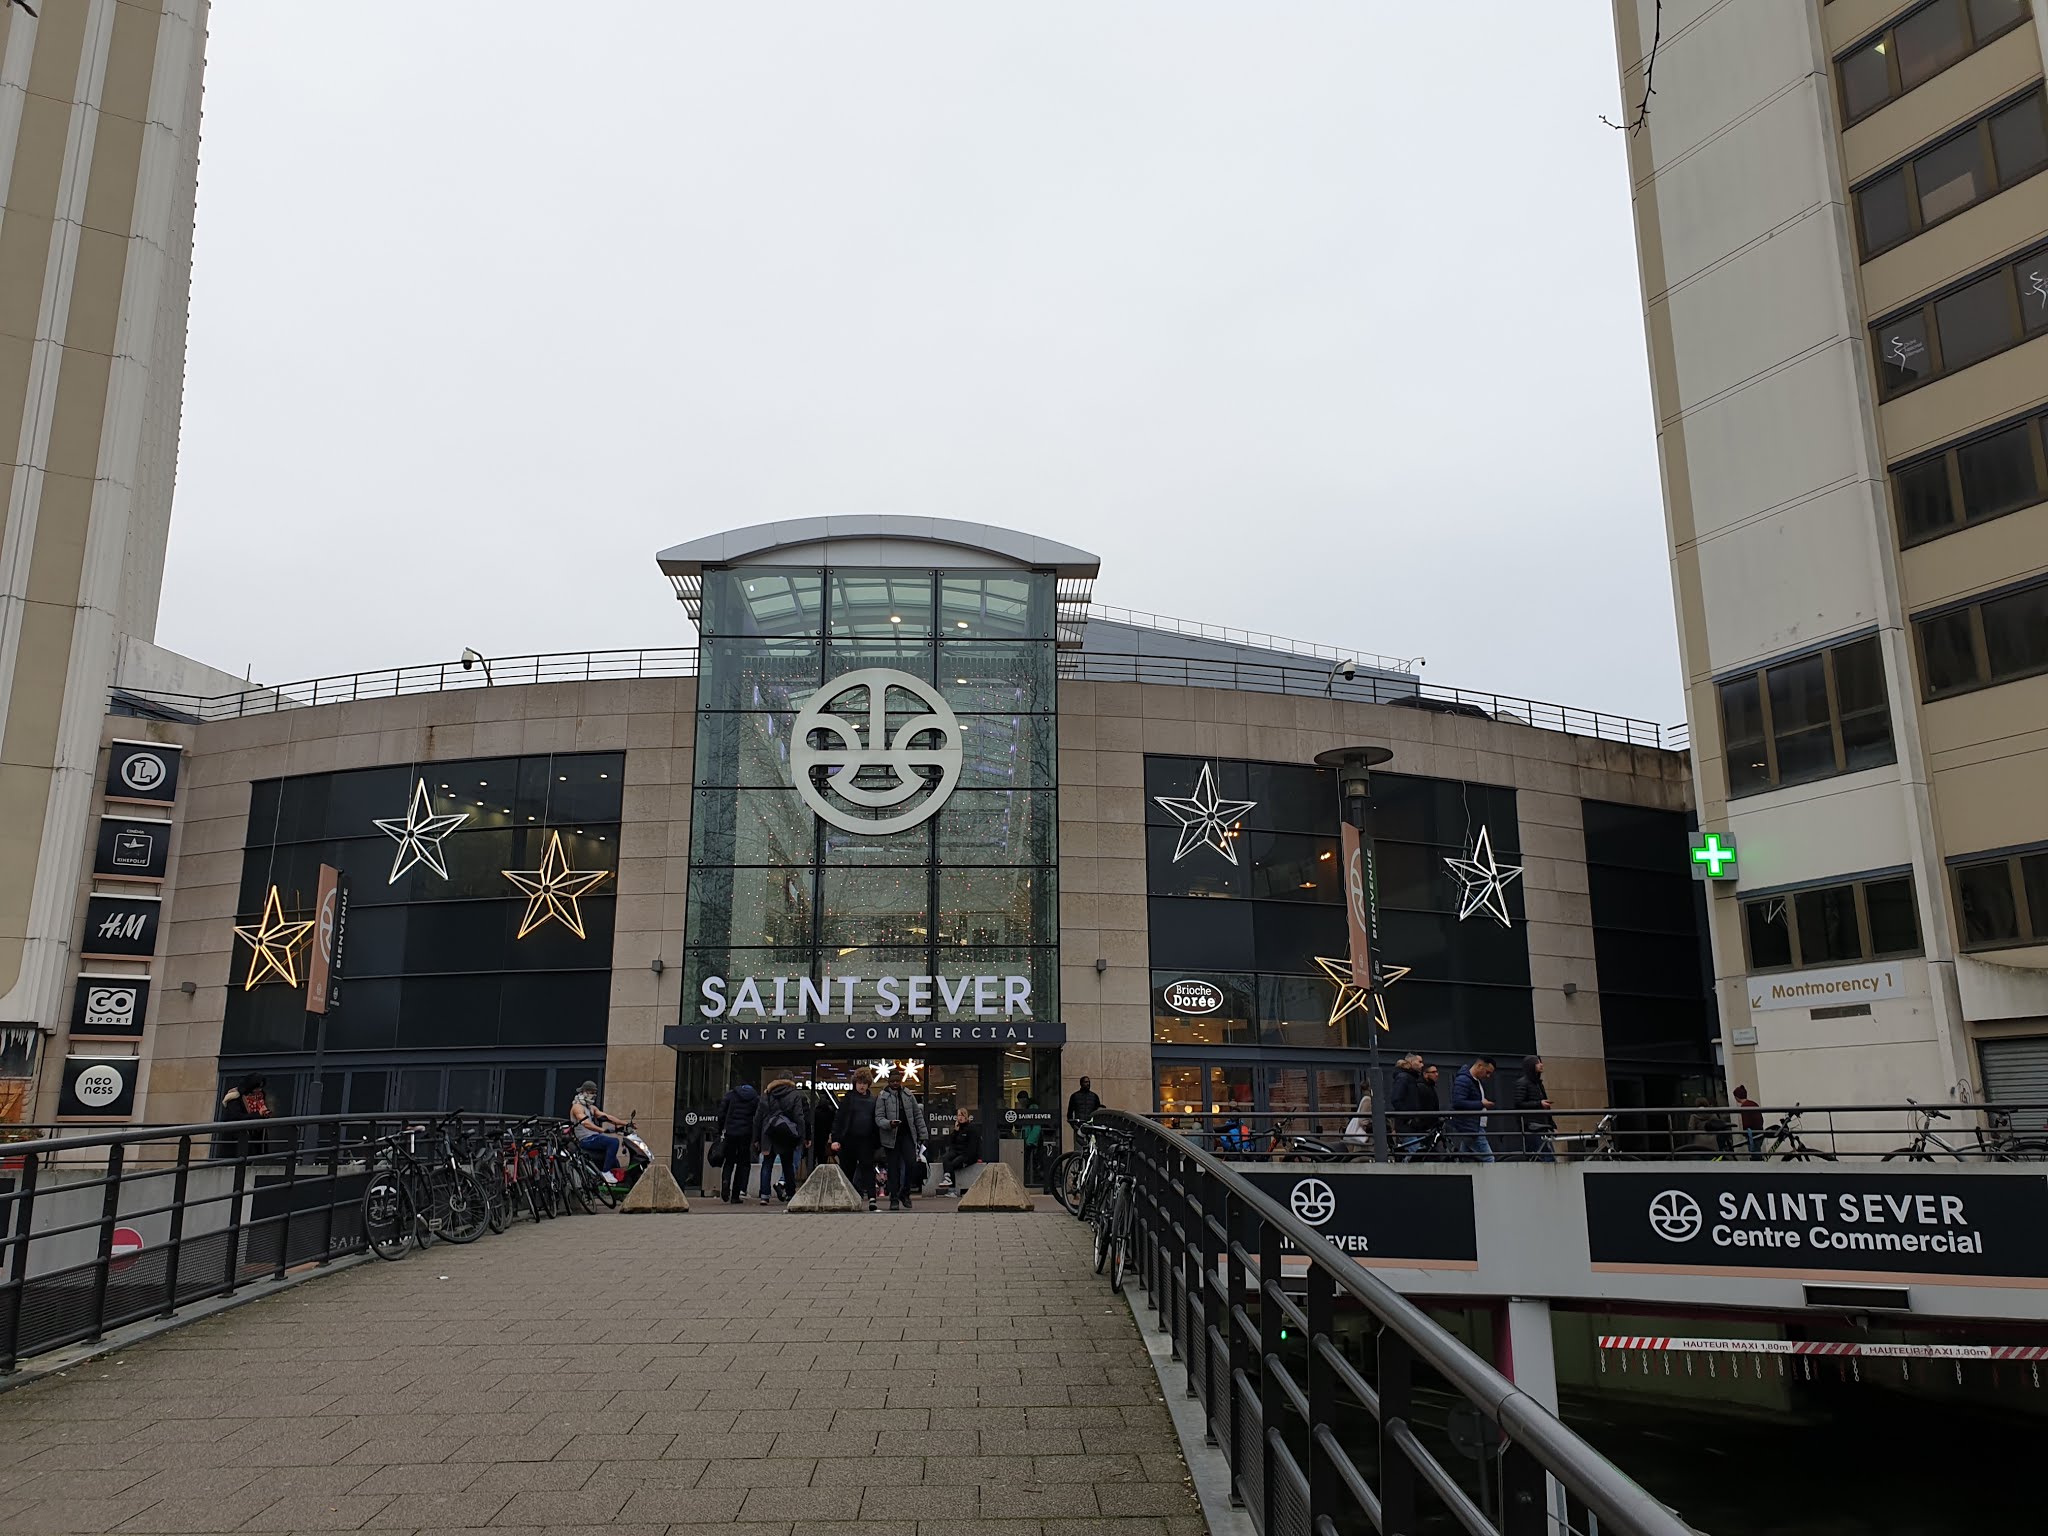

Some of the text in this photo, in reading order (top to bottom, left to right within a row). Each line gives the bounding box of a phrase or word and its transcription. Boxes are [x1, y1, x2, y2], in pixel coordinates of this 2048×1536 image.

[1366, 848, 1378, 940] BIENVENUE
[97, 912, 147, 941] H&M
[336, 887, 349, 969] BIENVENUE
[1176, 984, 1212, 996] Brioche
[1772, 972, 1893, 999] Montmorency 1
[89, 989, 134, 1015] GO
[700, 975, 1034, 1018] SAINT SEVER
[1173, 994, 1216, 1008] Dorée
[88, 1016, 130, 1024] SPORT
[700, 1026, 1034, 1041] CENTRE COMMERCIAL
[85, 1077, 112, 1086] neo
[83, 1085, 113, 1095] ness
[929, 1112, 974, 1121] Bienvee
[1718, 1192, 1968, 1225] SAINT SEVER
[1325, 1234, 1369, 1252] EVER
[1712, 1224, 1983, 1254] Centre Commercial
[1683, 1340, 1789, 1351] HAUTEUR MAXI 1.80m
[1869, 1346, 1987, 1356] HAUTEUR MAXI 1.80m
